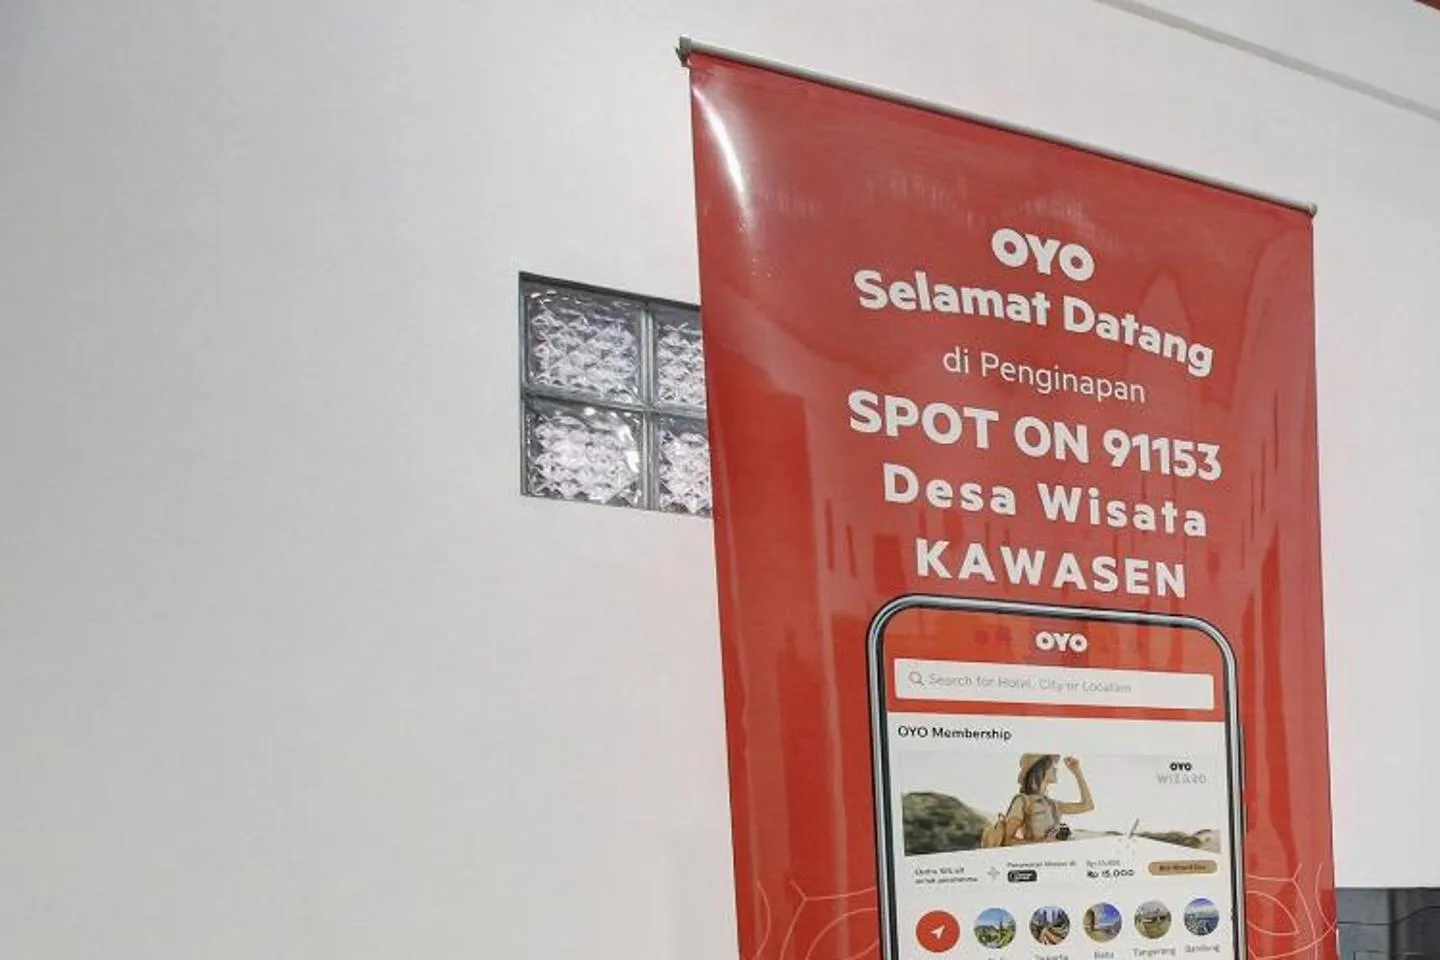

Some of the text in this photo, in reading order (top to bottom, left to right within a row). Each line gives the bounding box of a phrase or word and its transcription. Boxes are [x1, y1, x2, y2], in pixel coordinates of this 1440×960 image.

[991, 227, 1095, 281] OYO
[854, 270, 1213, 377] Selamat Datang
[943, 347, 1145, 403] di Penginapan
[848, 390, 1222, 480] SPOT ON 91153
[883, 462, 1207, 537] Desa Wisata
[916, 538, 1186, 598] KAWASEN
[1035, 631, 1088, 652] OYO
[929, 673, 972, 686] Search
[977, 676, 994, 686] for
[1039, 678, 1063, 693] City
[898, 726, 1011, 740] OYO Membership
[1170, 762, 1192, 771] OYO
